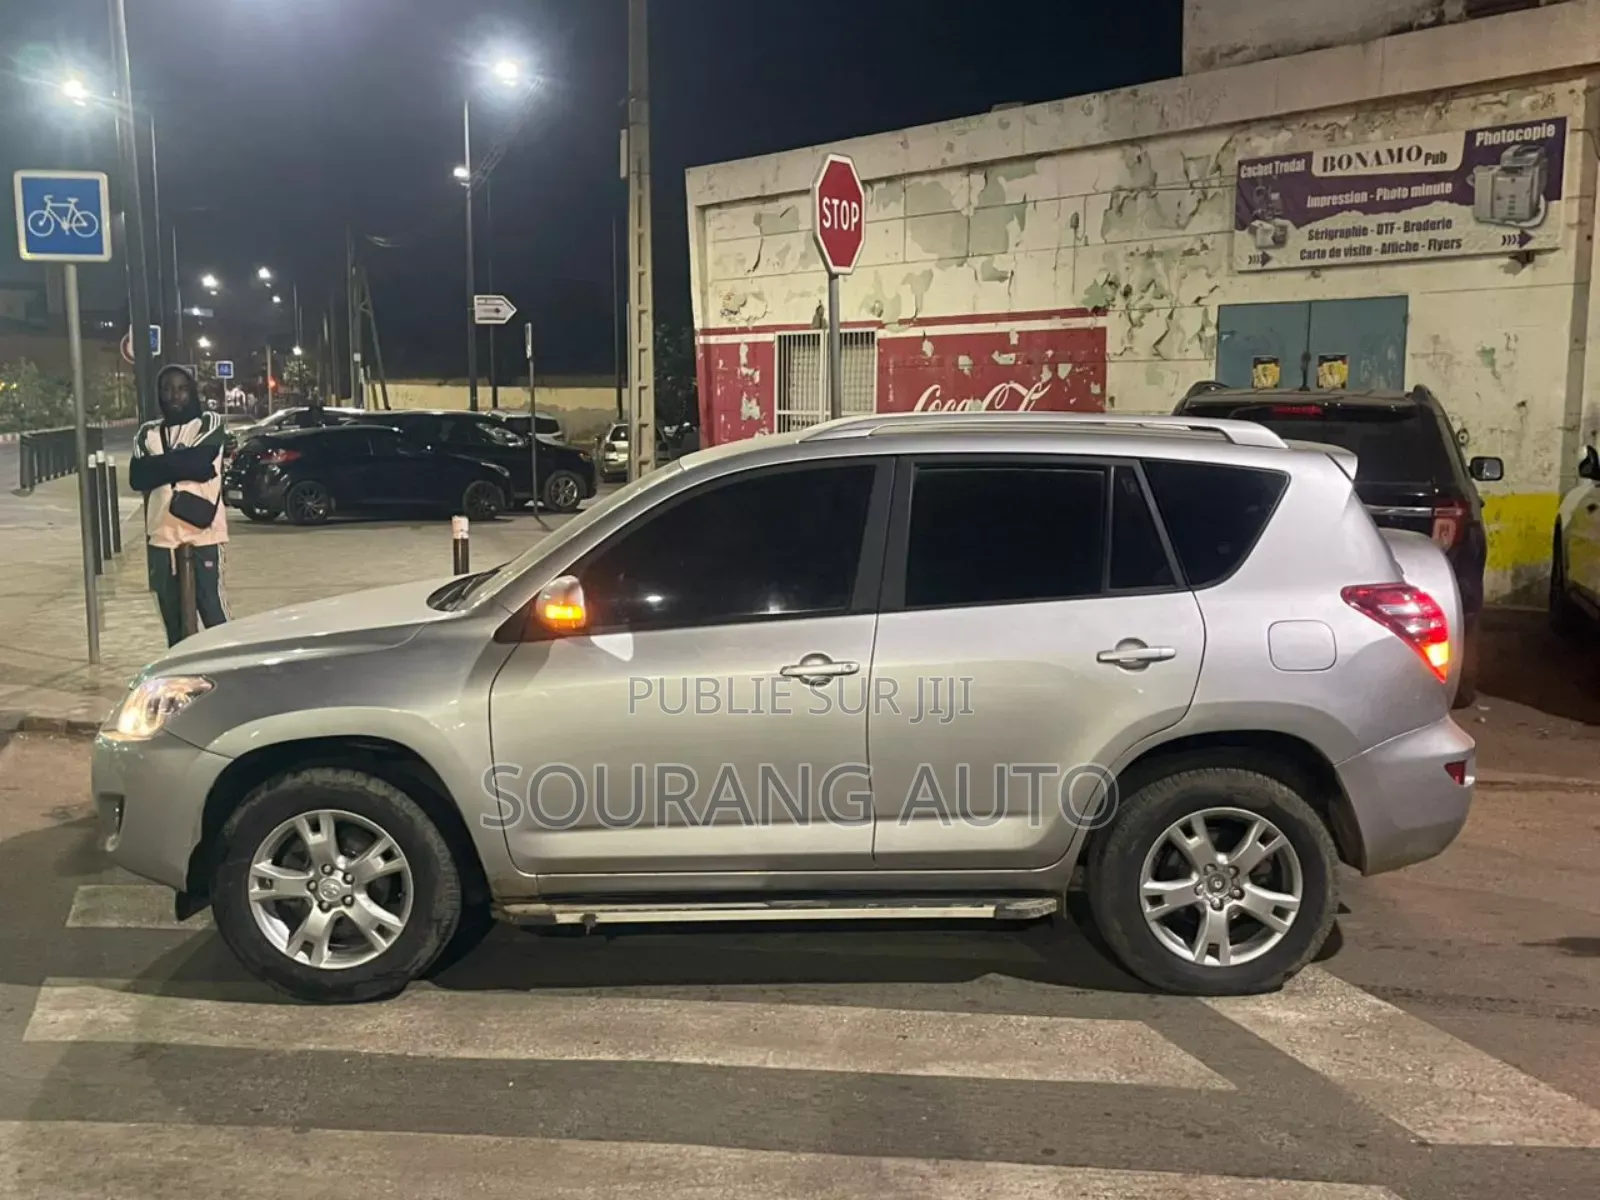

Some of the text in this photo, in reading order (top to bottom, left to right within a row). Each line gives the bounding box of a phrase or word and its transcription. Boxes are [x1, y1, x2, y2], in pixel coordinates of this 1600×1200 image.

[1475, 123, 1556, 147] Photocopie
[1322, 144, 1448, 173] BONAMO Pub
[1306, 190, 1368, 208] Impression
[1375, 186, 1409, 201] Photo
[1410, 181, 1453, 197] minute
[822, 196, 860, 231] STOP
[1376, 222, 1396, 235] DTF
[1403, 217, 1453, 233] Broderie
[1300, 249, 1327, 260] Carte
[1328, 246, 1342, 258] de
[1343, 244, 1372, 257] visite
[1380, 240, 1419, 255] Affiche
[1427, 238, 1463, 251] Flyers
